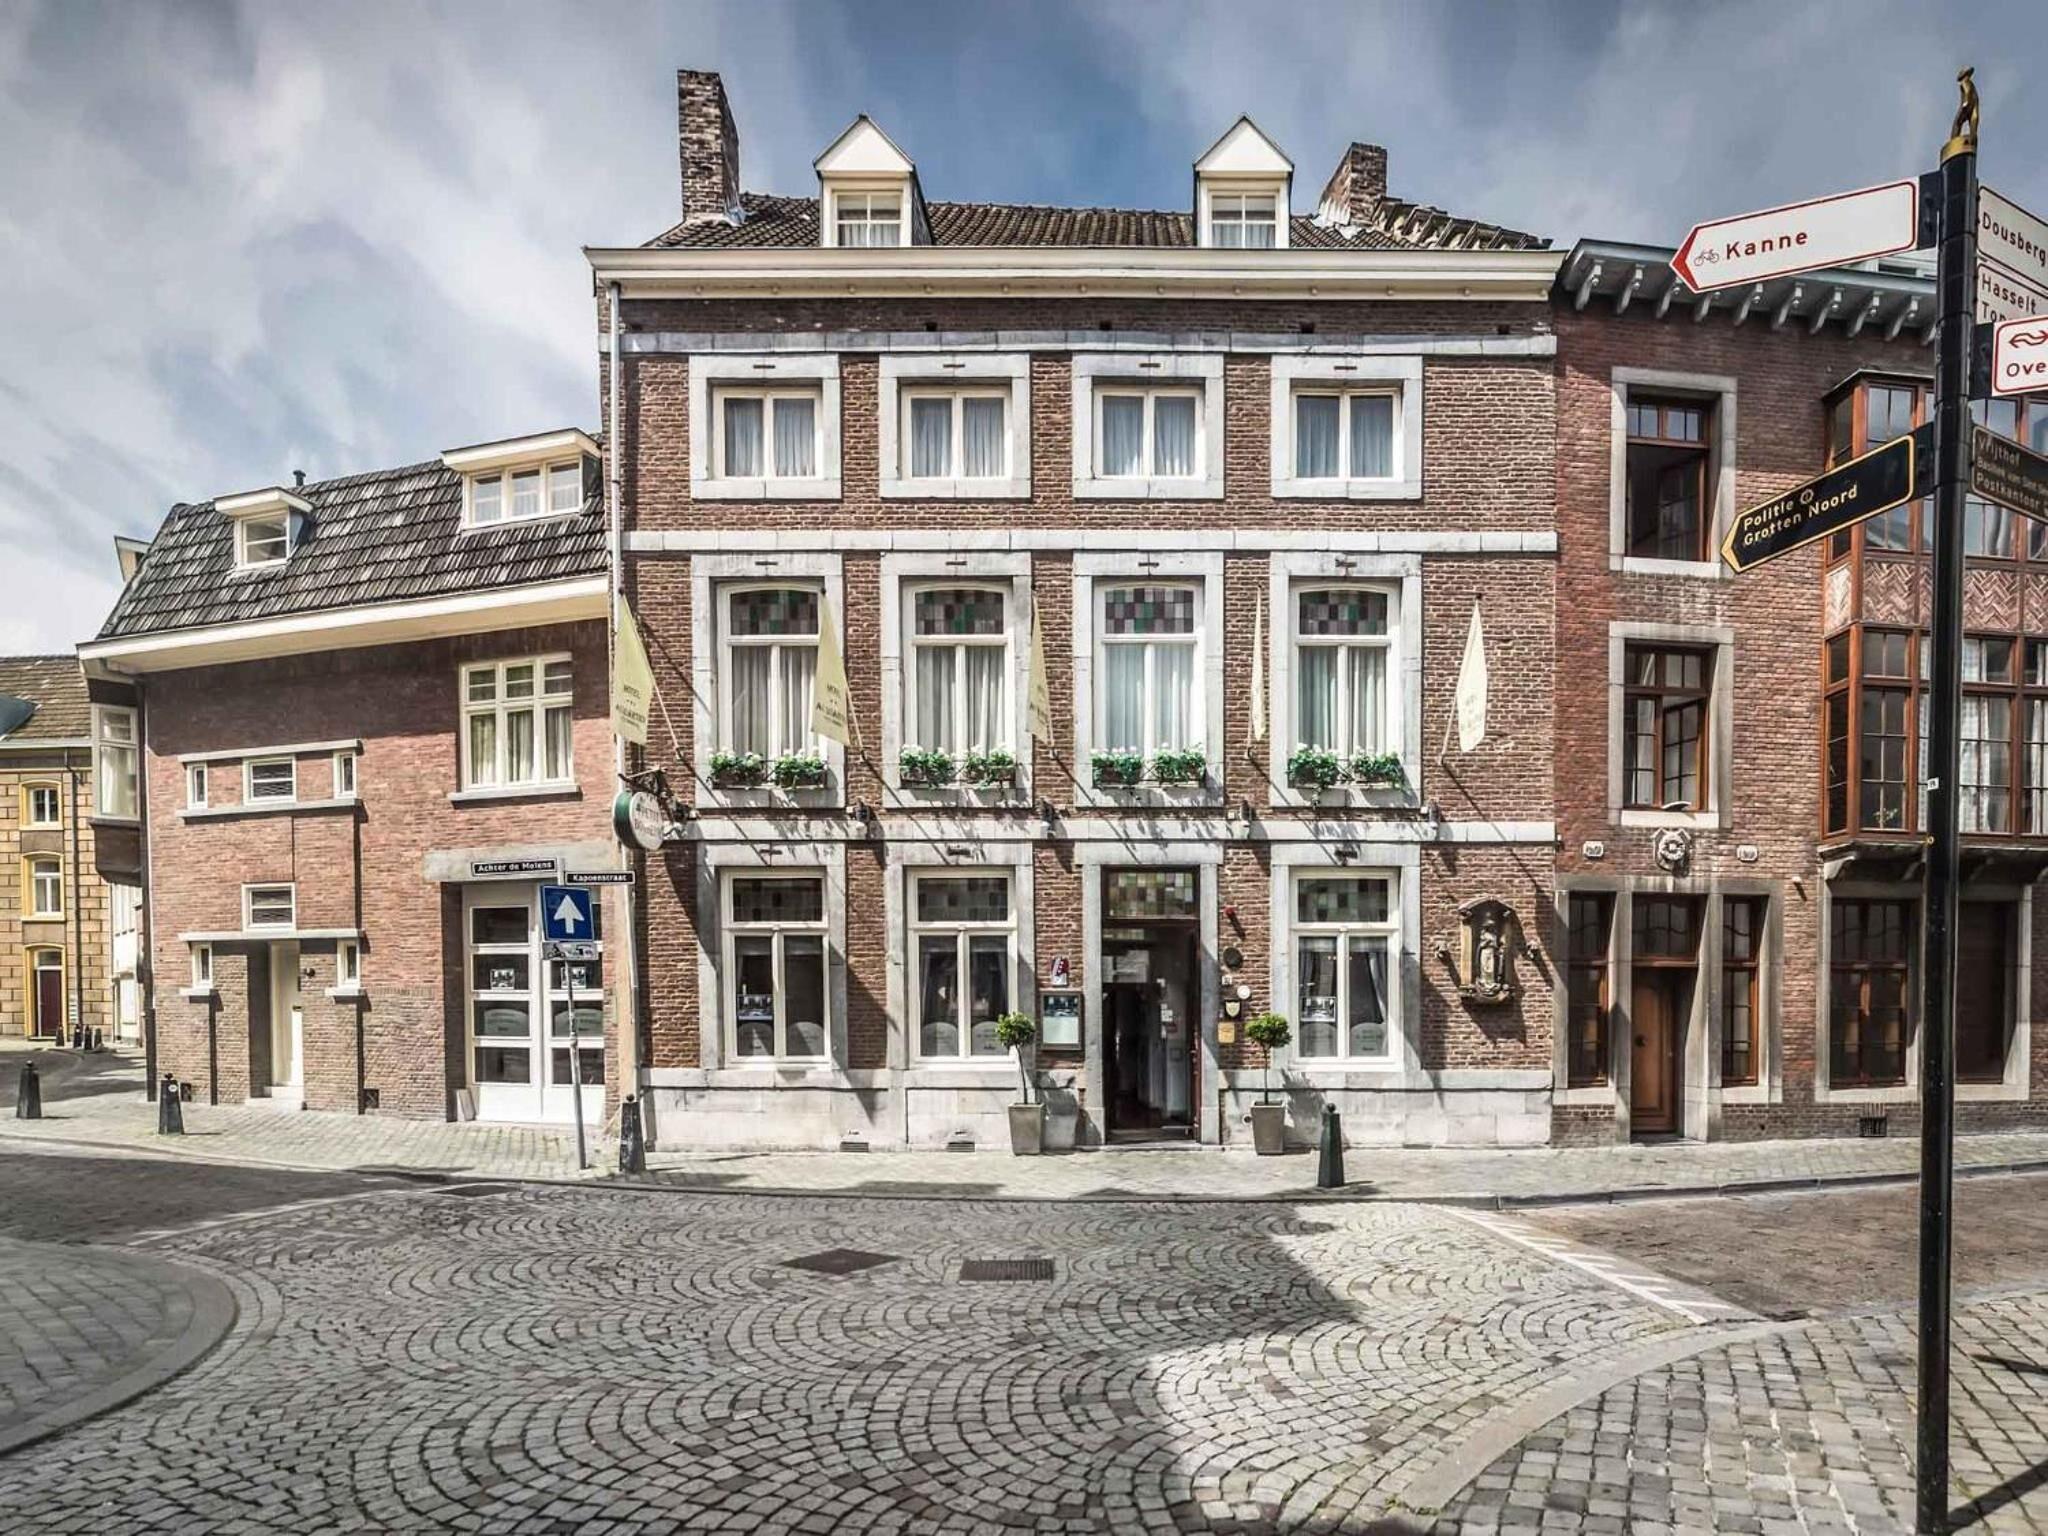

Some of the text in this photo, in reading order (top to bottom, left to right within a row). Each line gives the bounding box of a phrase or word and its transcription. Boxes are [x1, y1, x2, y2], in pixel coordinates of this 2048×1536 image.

[1726, 231, 1808, 260] Kanne
[1982, 211, 2047, 268] Dousberg
[1981, 273, 2037, 315] Hasselt
[1977, 436, 2020, 467] Vrijthof
[1976, 472, 2039, 510] Postkantoor
[1743, 499, 1794, 531] Politie
[1743, 484, 1858, 547] Grotten Noord
[477, 861, 552, 873] Achter de Molens
[572, 873, 627, 883] Kapoenstraat
